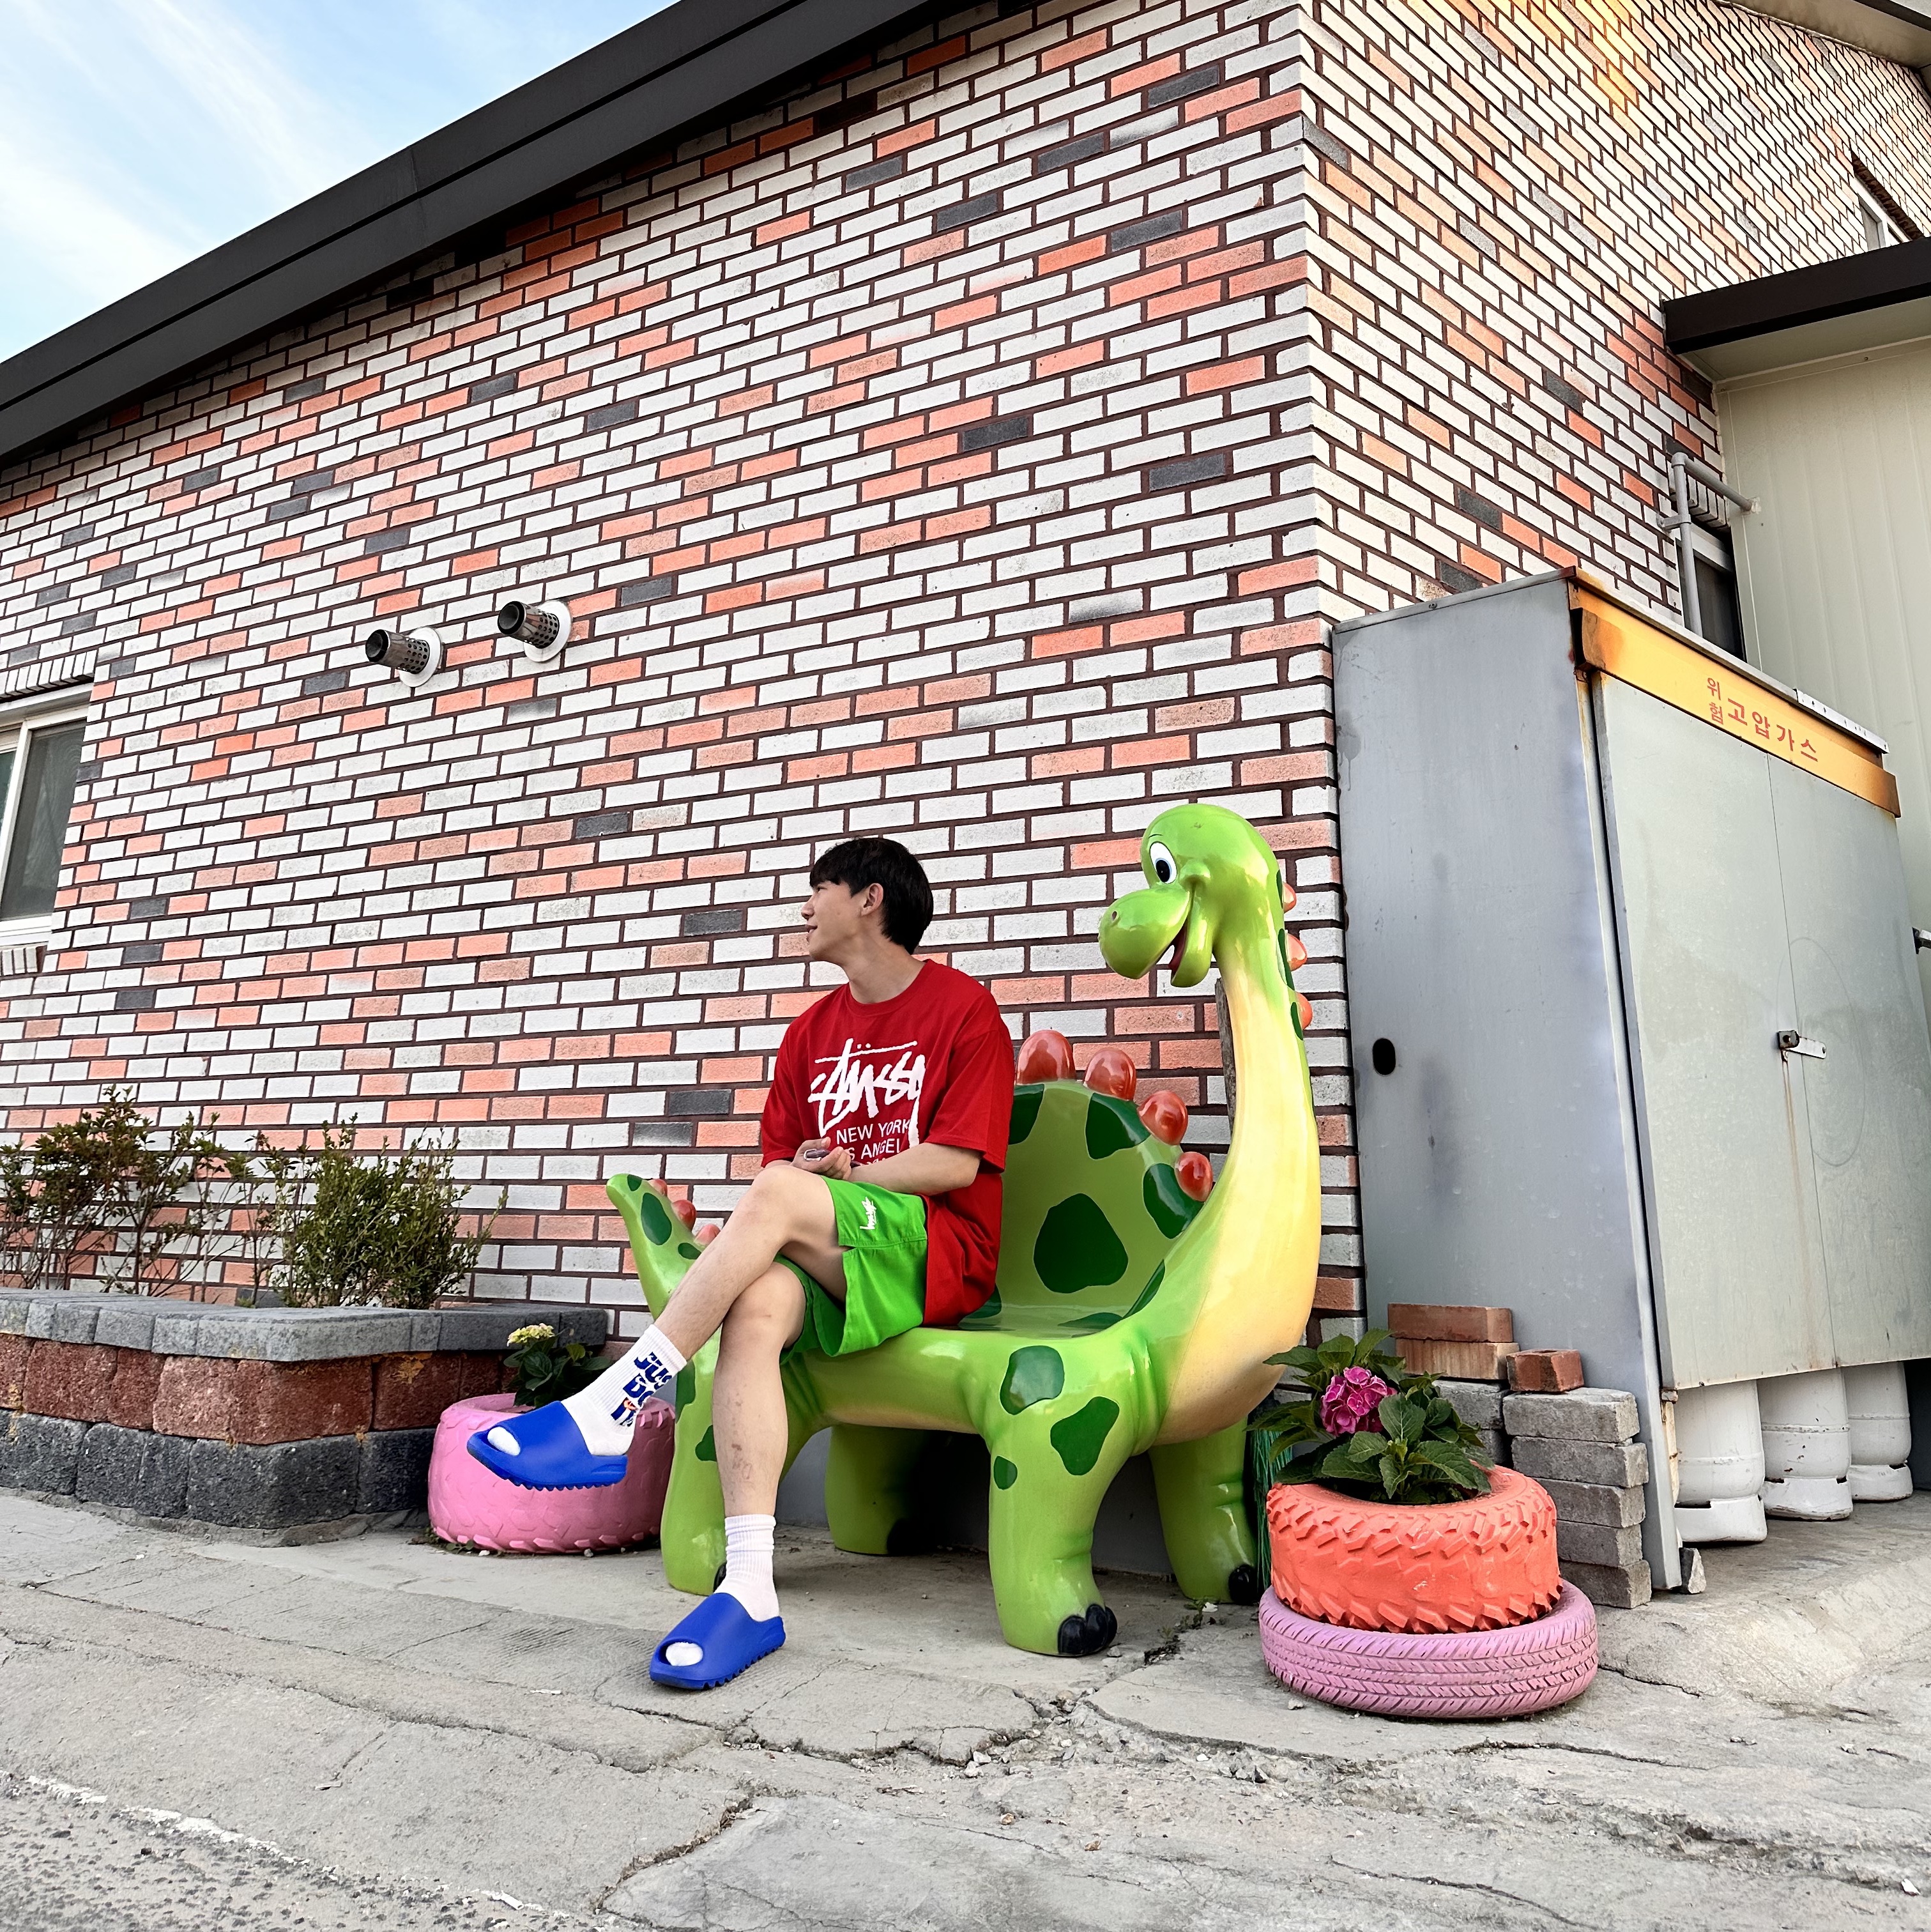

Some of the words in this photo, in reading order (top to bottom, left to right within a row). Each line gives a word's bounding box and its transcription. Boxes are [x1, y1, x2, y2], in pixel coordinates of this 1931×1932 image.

[1707, 677, 1723, 725] 위험
[1728, 698, 1818, 762] 고압가스
[836, 1123, 873, 1145] NEW
[878, 1119, 910, 1137] YORK
[860, 1138, 900, 1160] ANGEL
[633, 1351, 673, 1390] JUS
